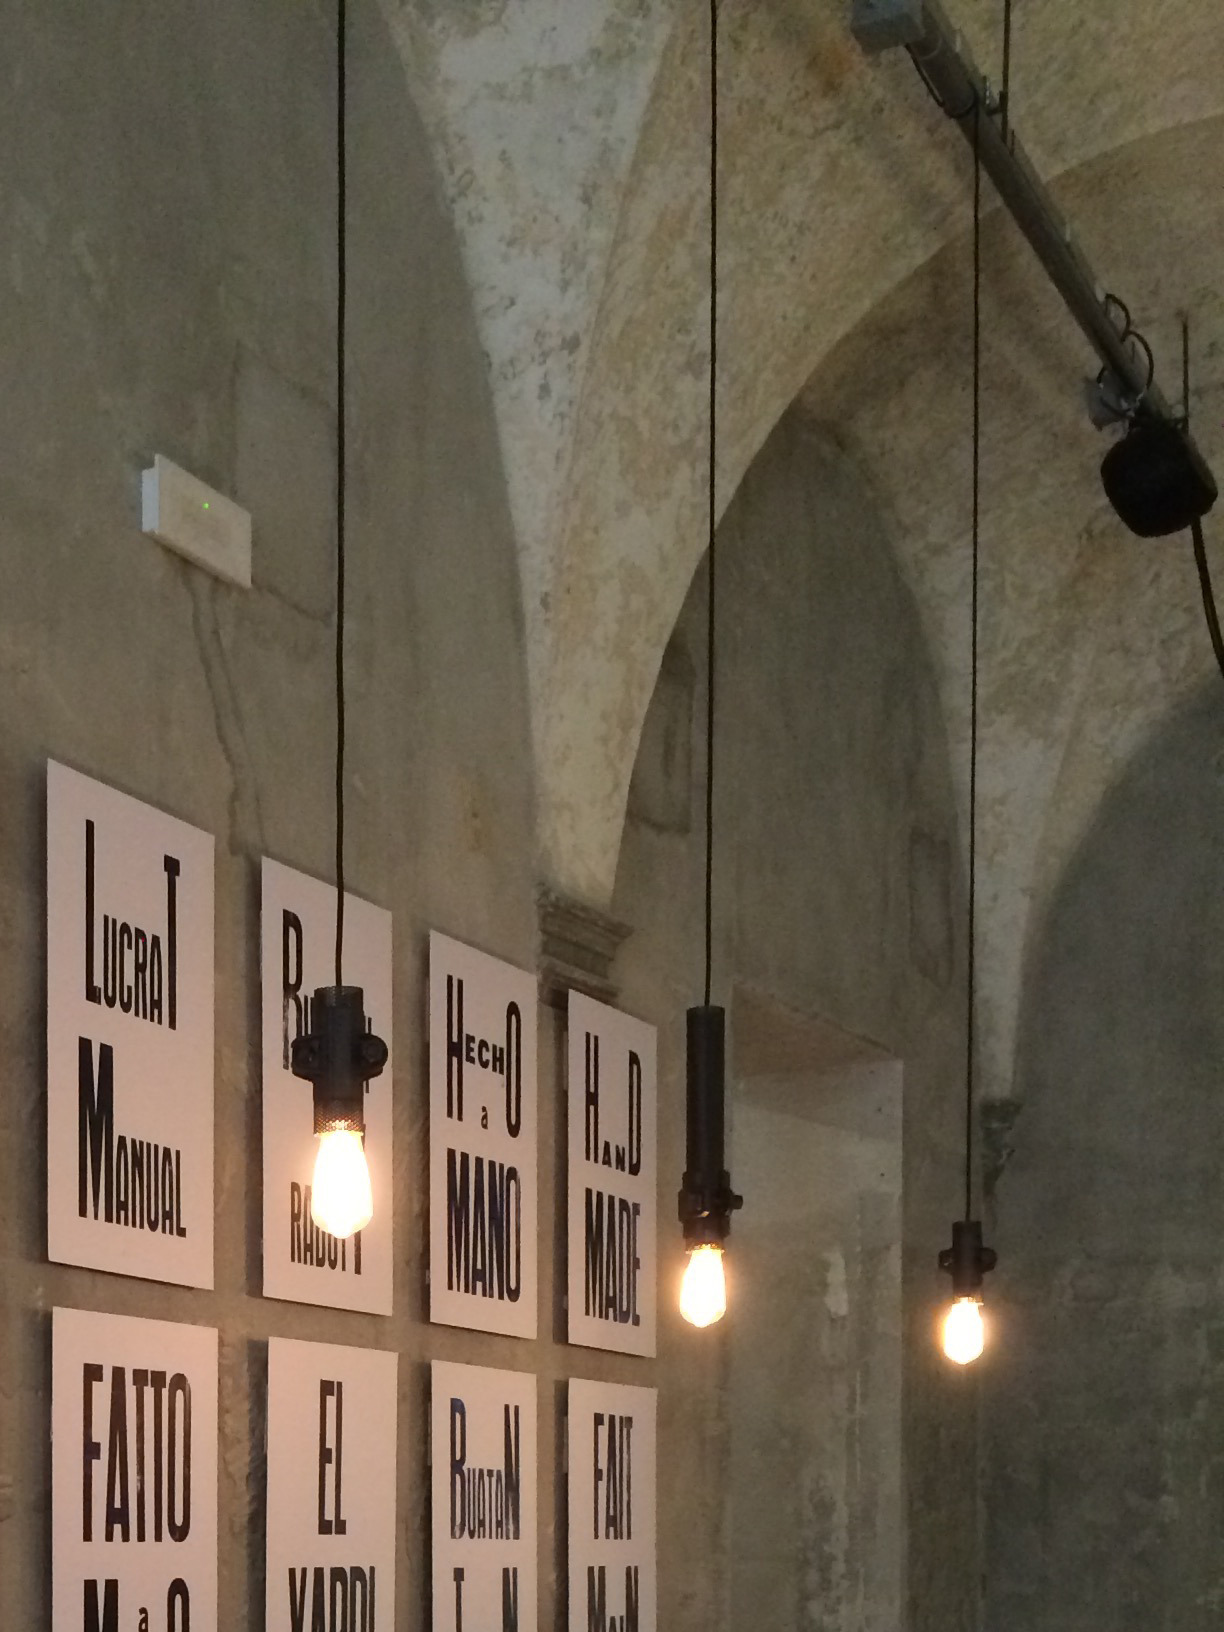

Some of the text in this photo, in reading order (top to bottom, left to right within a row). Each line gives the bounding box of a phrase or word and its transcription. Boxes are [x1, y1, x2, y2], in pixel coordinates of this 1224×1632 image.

[85, 819, 181, 1030] LUCRAT
[446, 975, 522, 1139] HECHO
[584, 1031, 642, 1177] HAND
[78, 1036, 186, 1238] MANUAL
[446, 1148, 522, 1303] MANO
[584, 1187, 641, 1327] MADE
[82, 1362, 192, 1543] FATTO
[317, 1378, 347, 1536] EL
[449, 1397, 521, 1541] BUATAN
[593, 1412, 634, 1541] FAIT
